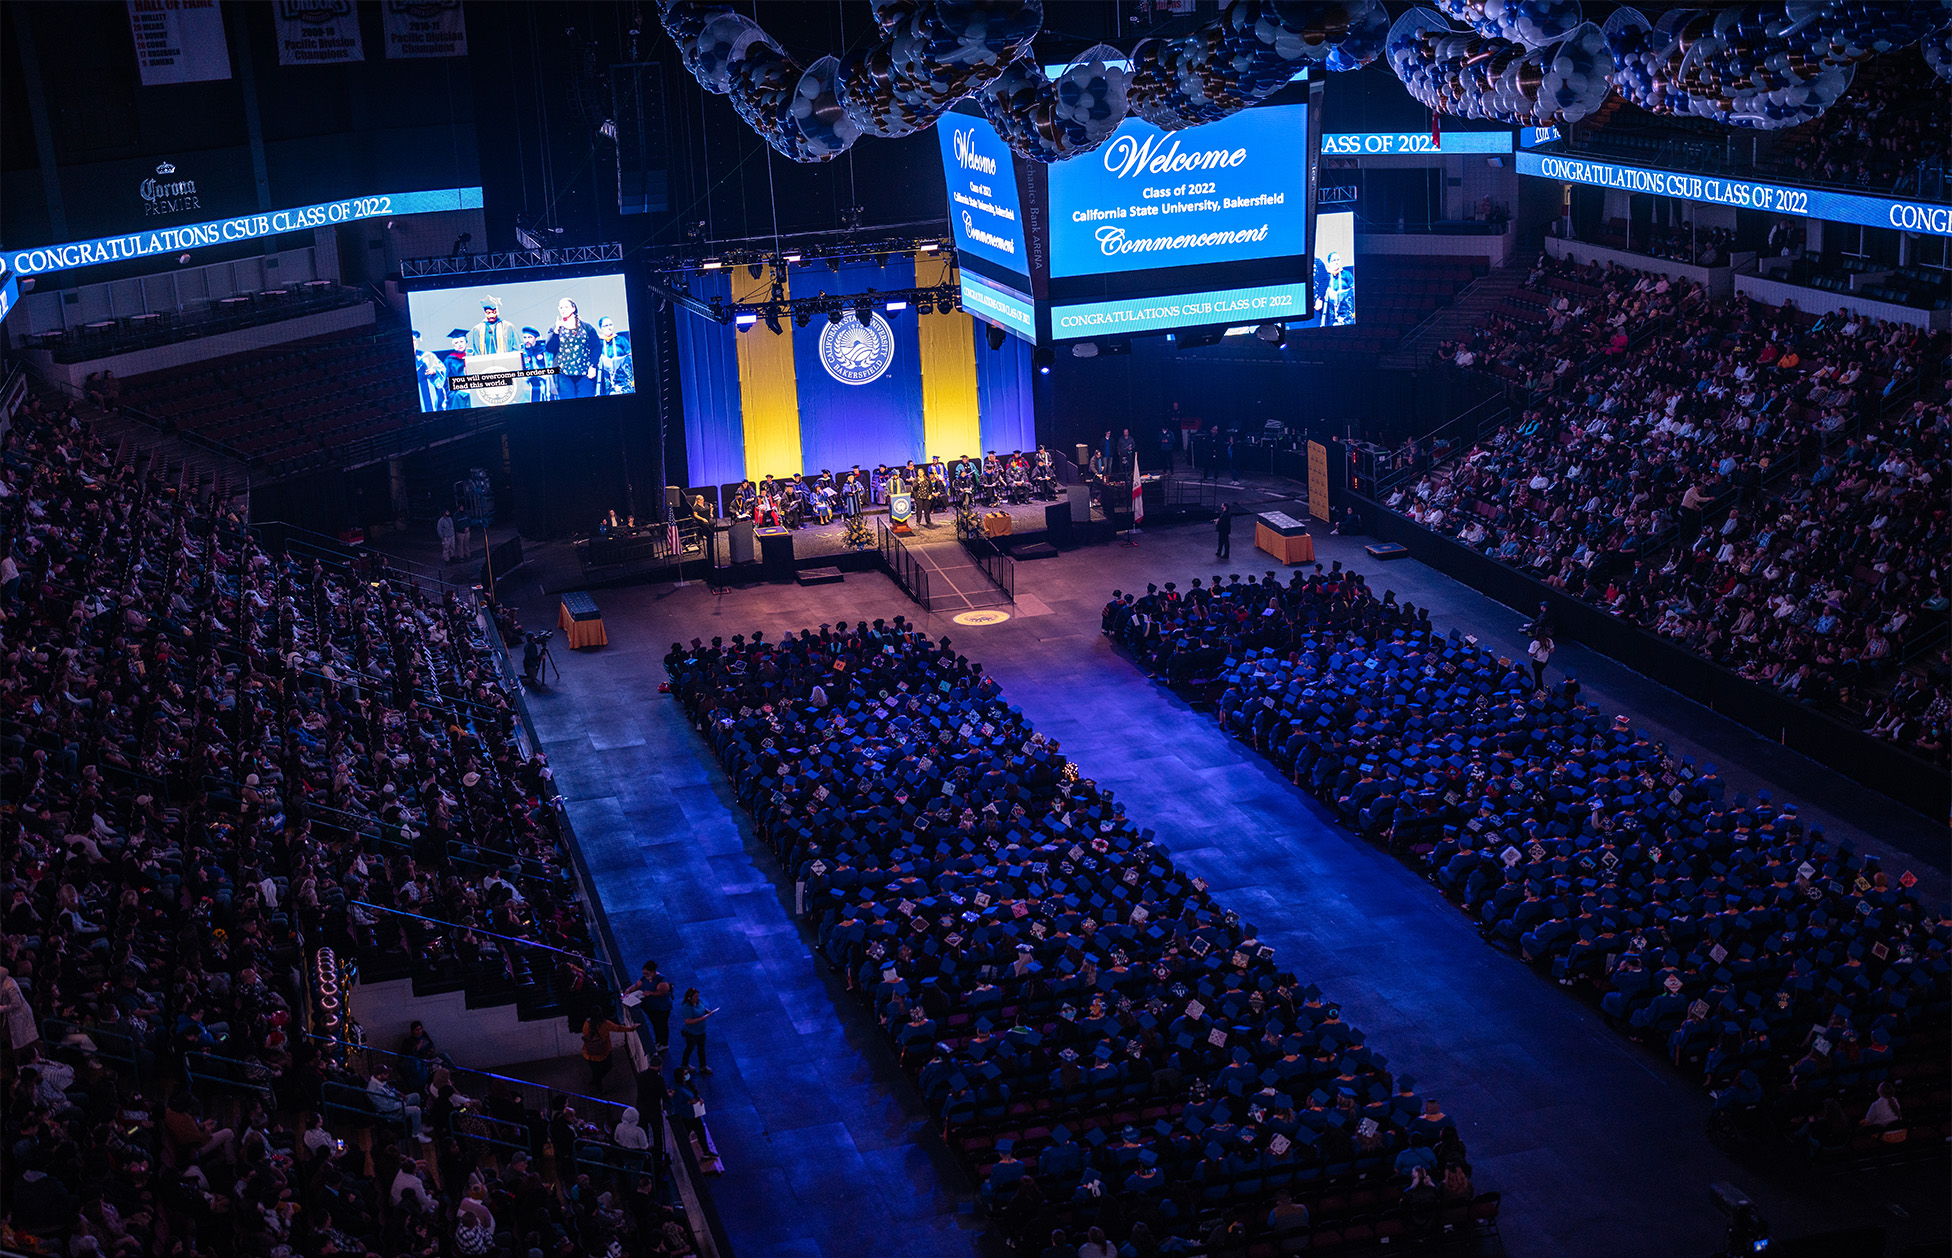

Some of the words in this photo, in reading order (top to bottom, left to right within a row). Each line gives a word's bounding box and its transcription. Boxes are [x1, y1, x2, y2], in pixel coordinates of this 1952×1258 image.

[285, 39, 318, 50] Pacific
[319, 38, 356, 49] Division
[391, 32, 425, 44] Pacific
[401, 43, 455, 54] Champions
[295, 49, 349, 61] Champions
[1103, 127, 1247, 179] Welcome
[1365, 135, 1393, 152] OF
[140, 177, 197, 203] Corona
[1143, 186, 1171, 199] Class
[1173, 184, 1187, 197] of
[1188, 182, 1216, 196] 2022
[1541, 158, 1665, 194] CONGRATULATIONS
[1666, 176, 1702, 199] CSUB
[1705, 181, 1750, 205] CLASS
[1751, 186, 1774, 209] OF
[1776, 190, 1808, 214] 2022
[144, 196, 201, 216] PREMIER
[1072, 206, 1127, 222] California
[1129, 204, 1159, 218] State
[1161, 199, 1221, 216] University,
[1223, 192, 1285, 209] Bakersfield
[1030, 207, 1041, 234] Bank
[14, 224, 220, 274] CONGRATULATIONS
[222, 217, 270, 240] CSUB
[272, 206, 326, 232] CLASS
[328, 202, 351, 222] OF
[353, 197, 392, 218] 2022
[1095, 223, 1269, 256] Commencement
[1032, 235, 1043, 270] ARENA
[1061, 306, 1181, 327] CONGRATULATIONS
[1182, 303, 1212, 317] CSUB
[1214, 298, 1250, 313] CLASS
[1252, 296, 1268, 309] OF
[1269, 294, 1293, 308] 2022
[870, 319, 889, 358] NIVERSITY
[452, 376, 466, 384] you
[466, 374, 480, 382] will
[481, 371, 516, 380] overcome
[526, 368, 546, 376] order
[833, 359, 883, 379] BAKERSFIELD
[452, 382, 468, 390] lead
[470, 380, 484, 389] this
[484, 379, 508, 388] world.
